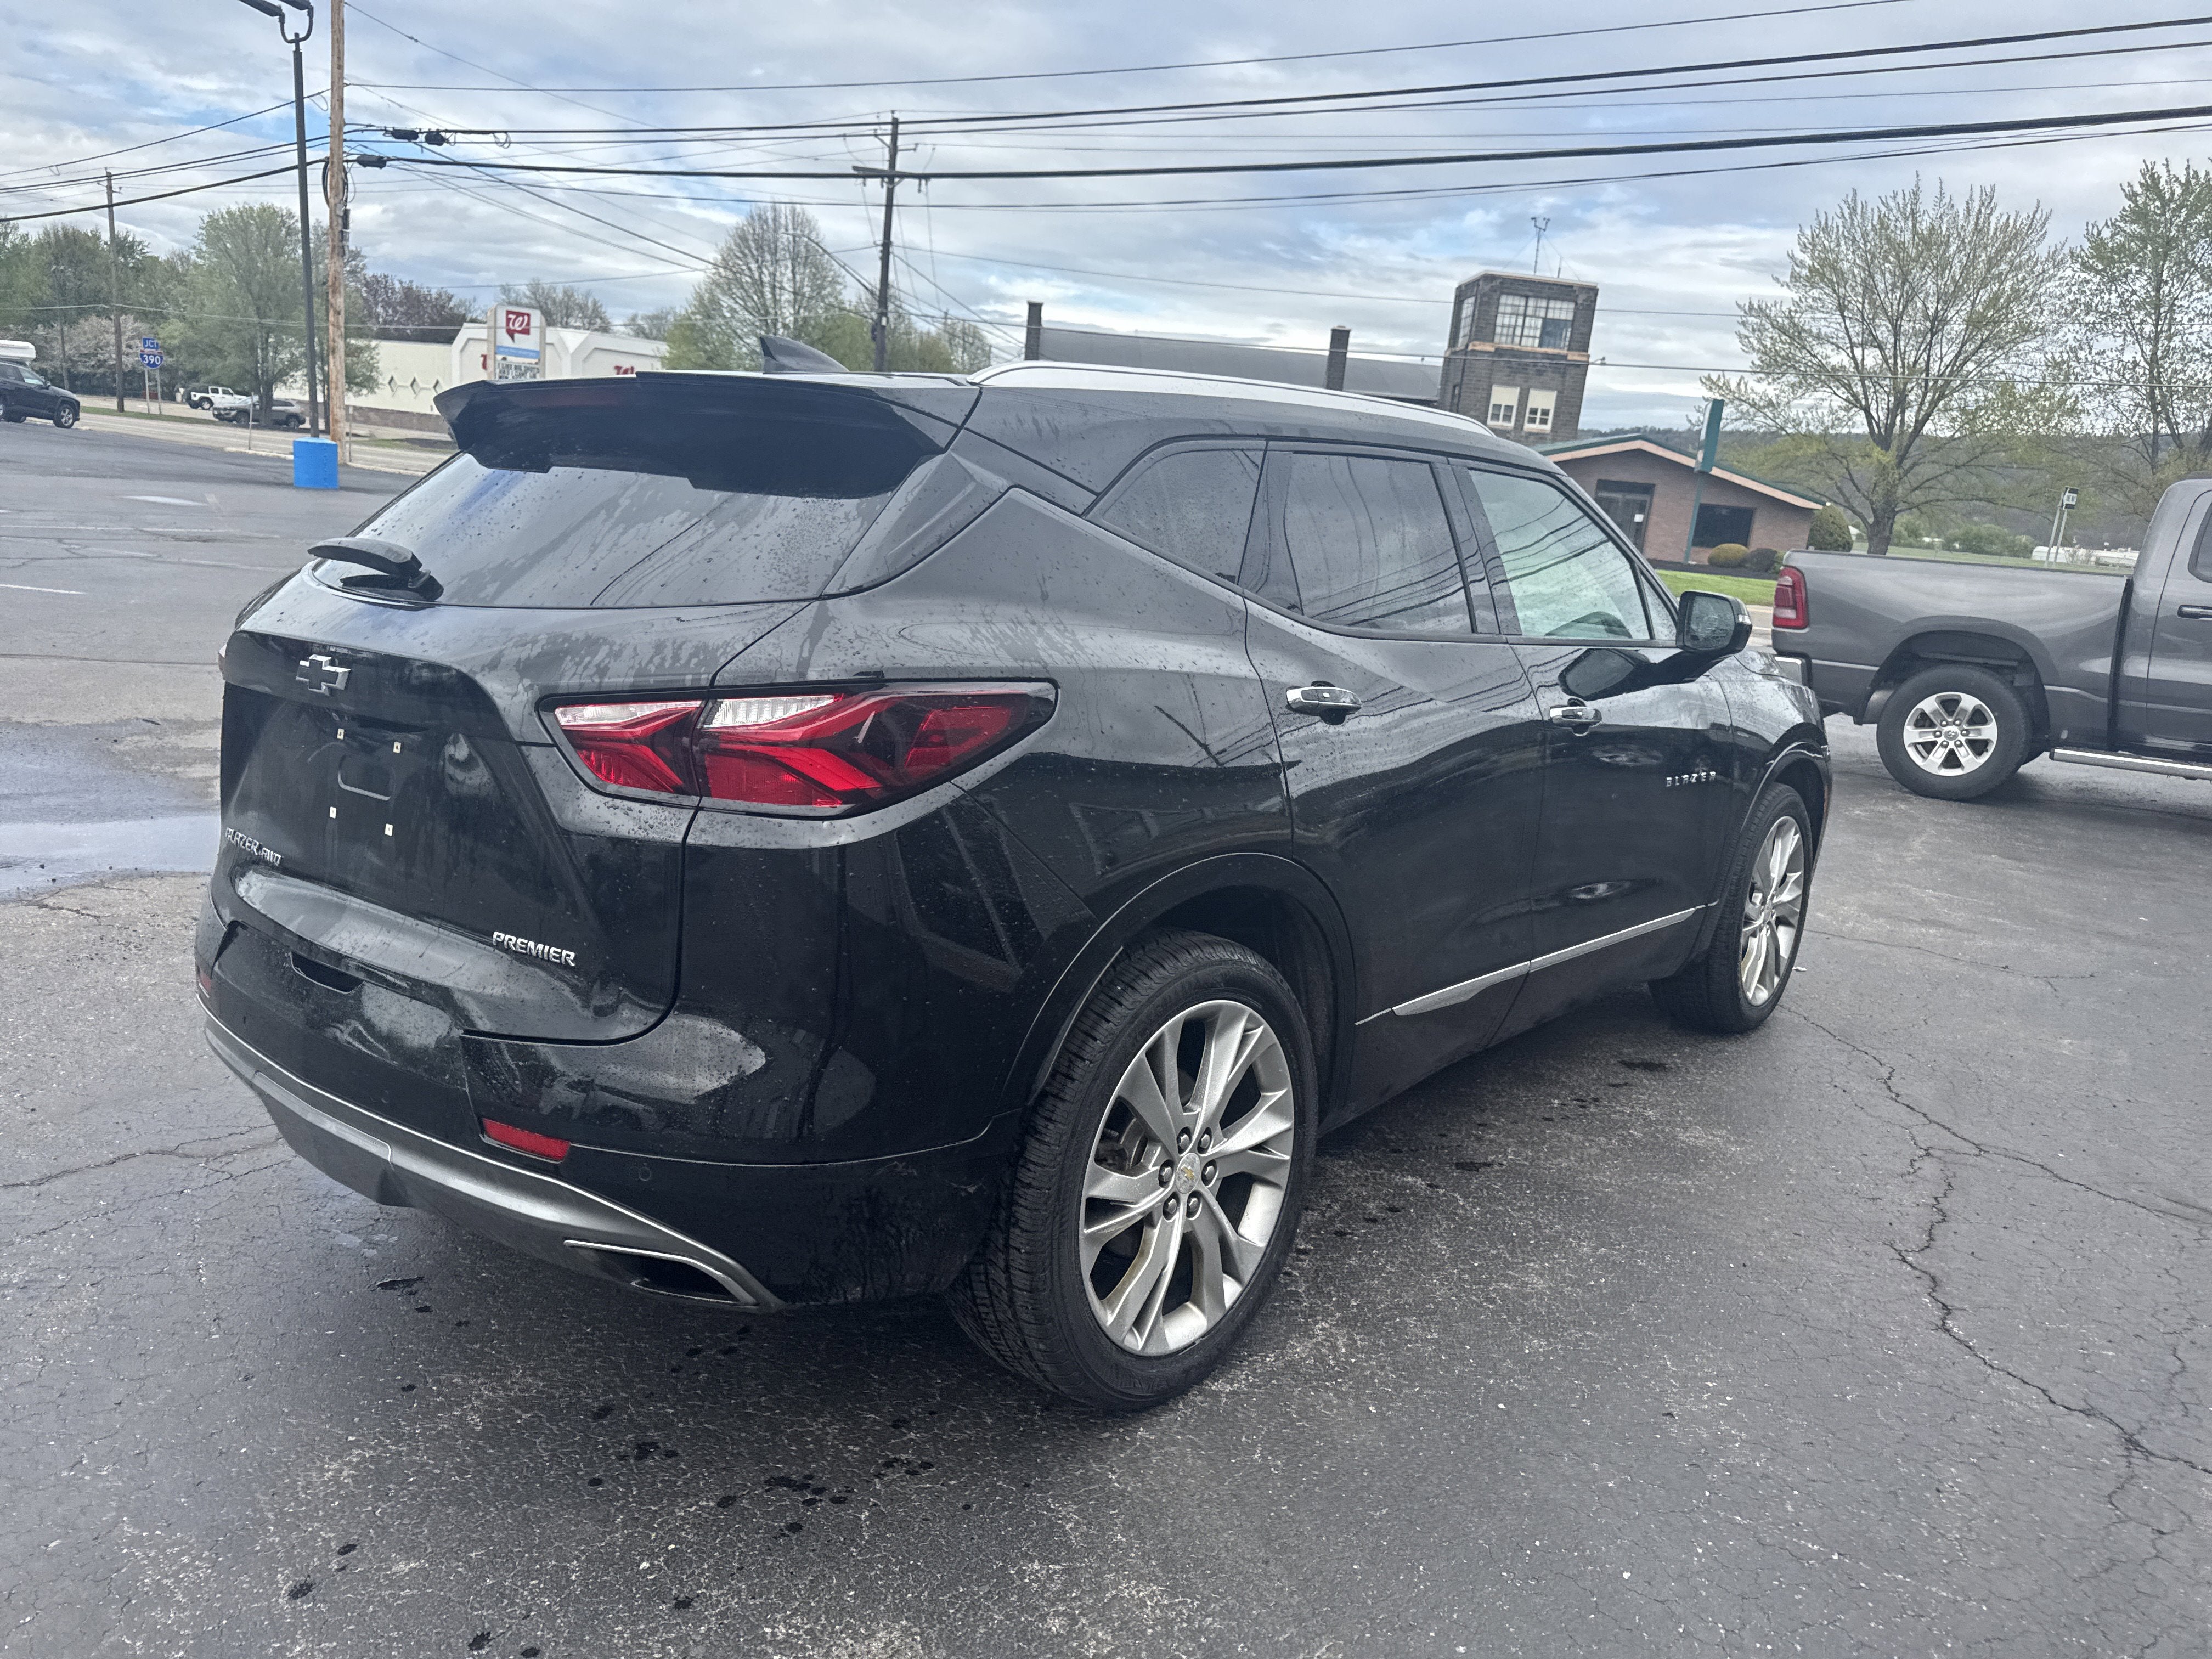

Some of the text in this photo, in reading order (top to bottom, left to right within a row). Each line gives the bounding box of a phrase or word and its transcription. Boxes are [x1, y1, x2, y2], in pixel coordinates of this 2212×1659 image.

[144, 340, 157, 348] JCT
[143, 354, 161, 365] 390
[1666, 771, 1716, 787] BLAZER
[225, 827, 281, 866] BLAZER AWD
[493, 932, 575, 967] PREMIER
